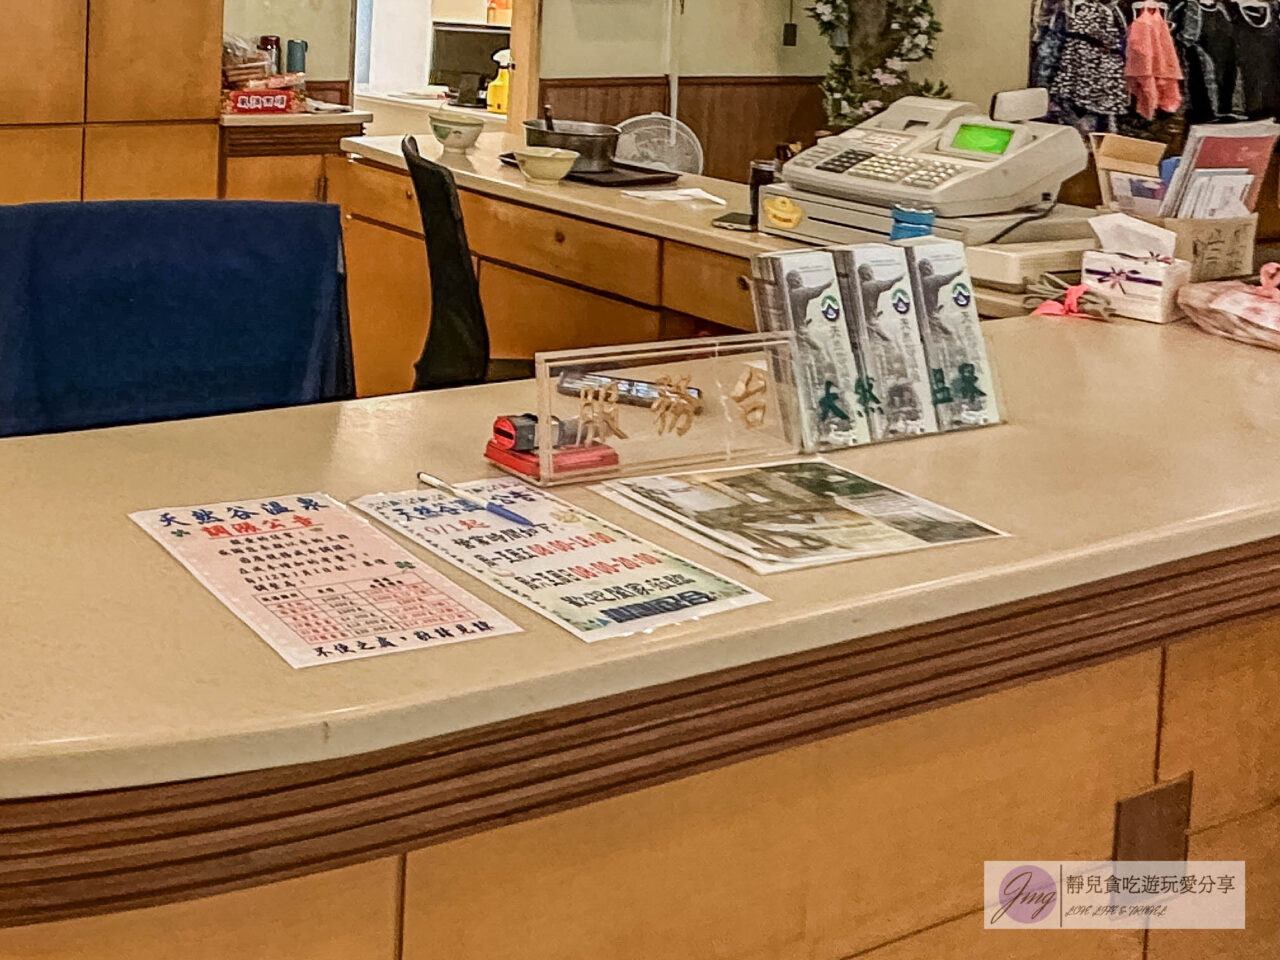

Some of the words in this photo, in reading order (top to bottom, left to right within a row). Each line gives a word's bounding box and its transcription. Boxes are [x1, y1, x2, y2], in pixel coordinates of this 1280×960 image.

[160, 497, 329, 527] 天然谷溫泉
[392, 490, 536, 521] 天然谷溫公告
